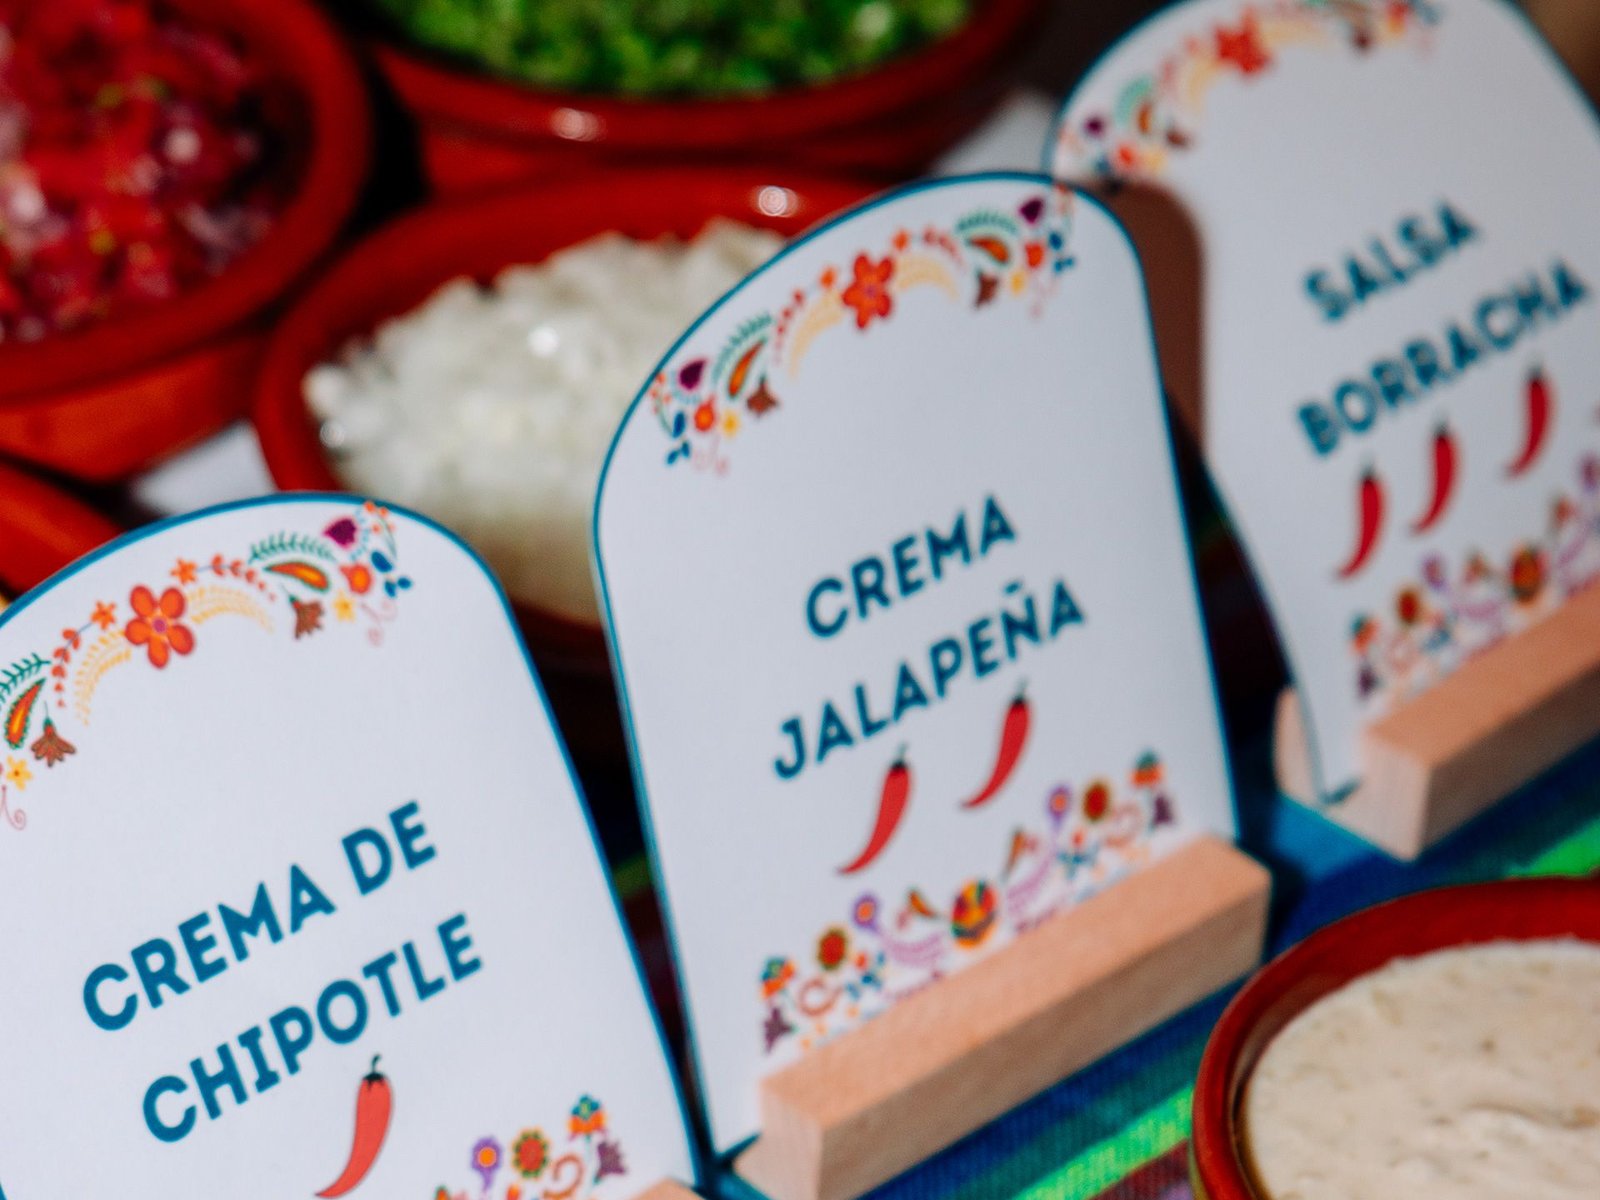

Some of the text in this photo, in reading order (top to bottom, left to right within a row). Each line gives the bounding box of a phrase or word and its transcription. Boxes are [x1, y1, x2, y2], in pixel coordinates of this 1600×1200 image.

[1297, 261, 1590, 457] BORRACHA
[1303, 202, 1478, 322] SALSA
[805, 495, 1017, 639] CREMA
[773, 580, 1085, 781] JALAPEÑA
[82, 801, 437, 1032] CREMA DE
[142, 913, 483, 1144] CHIPOTLE
